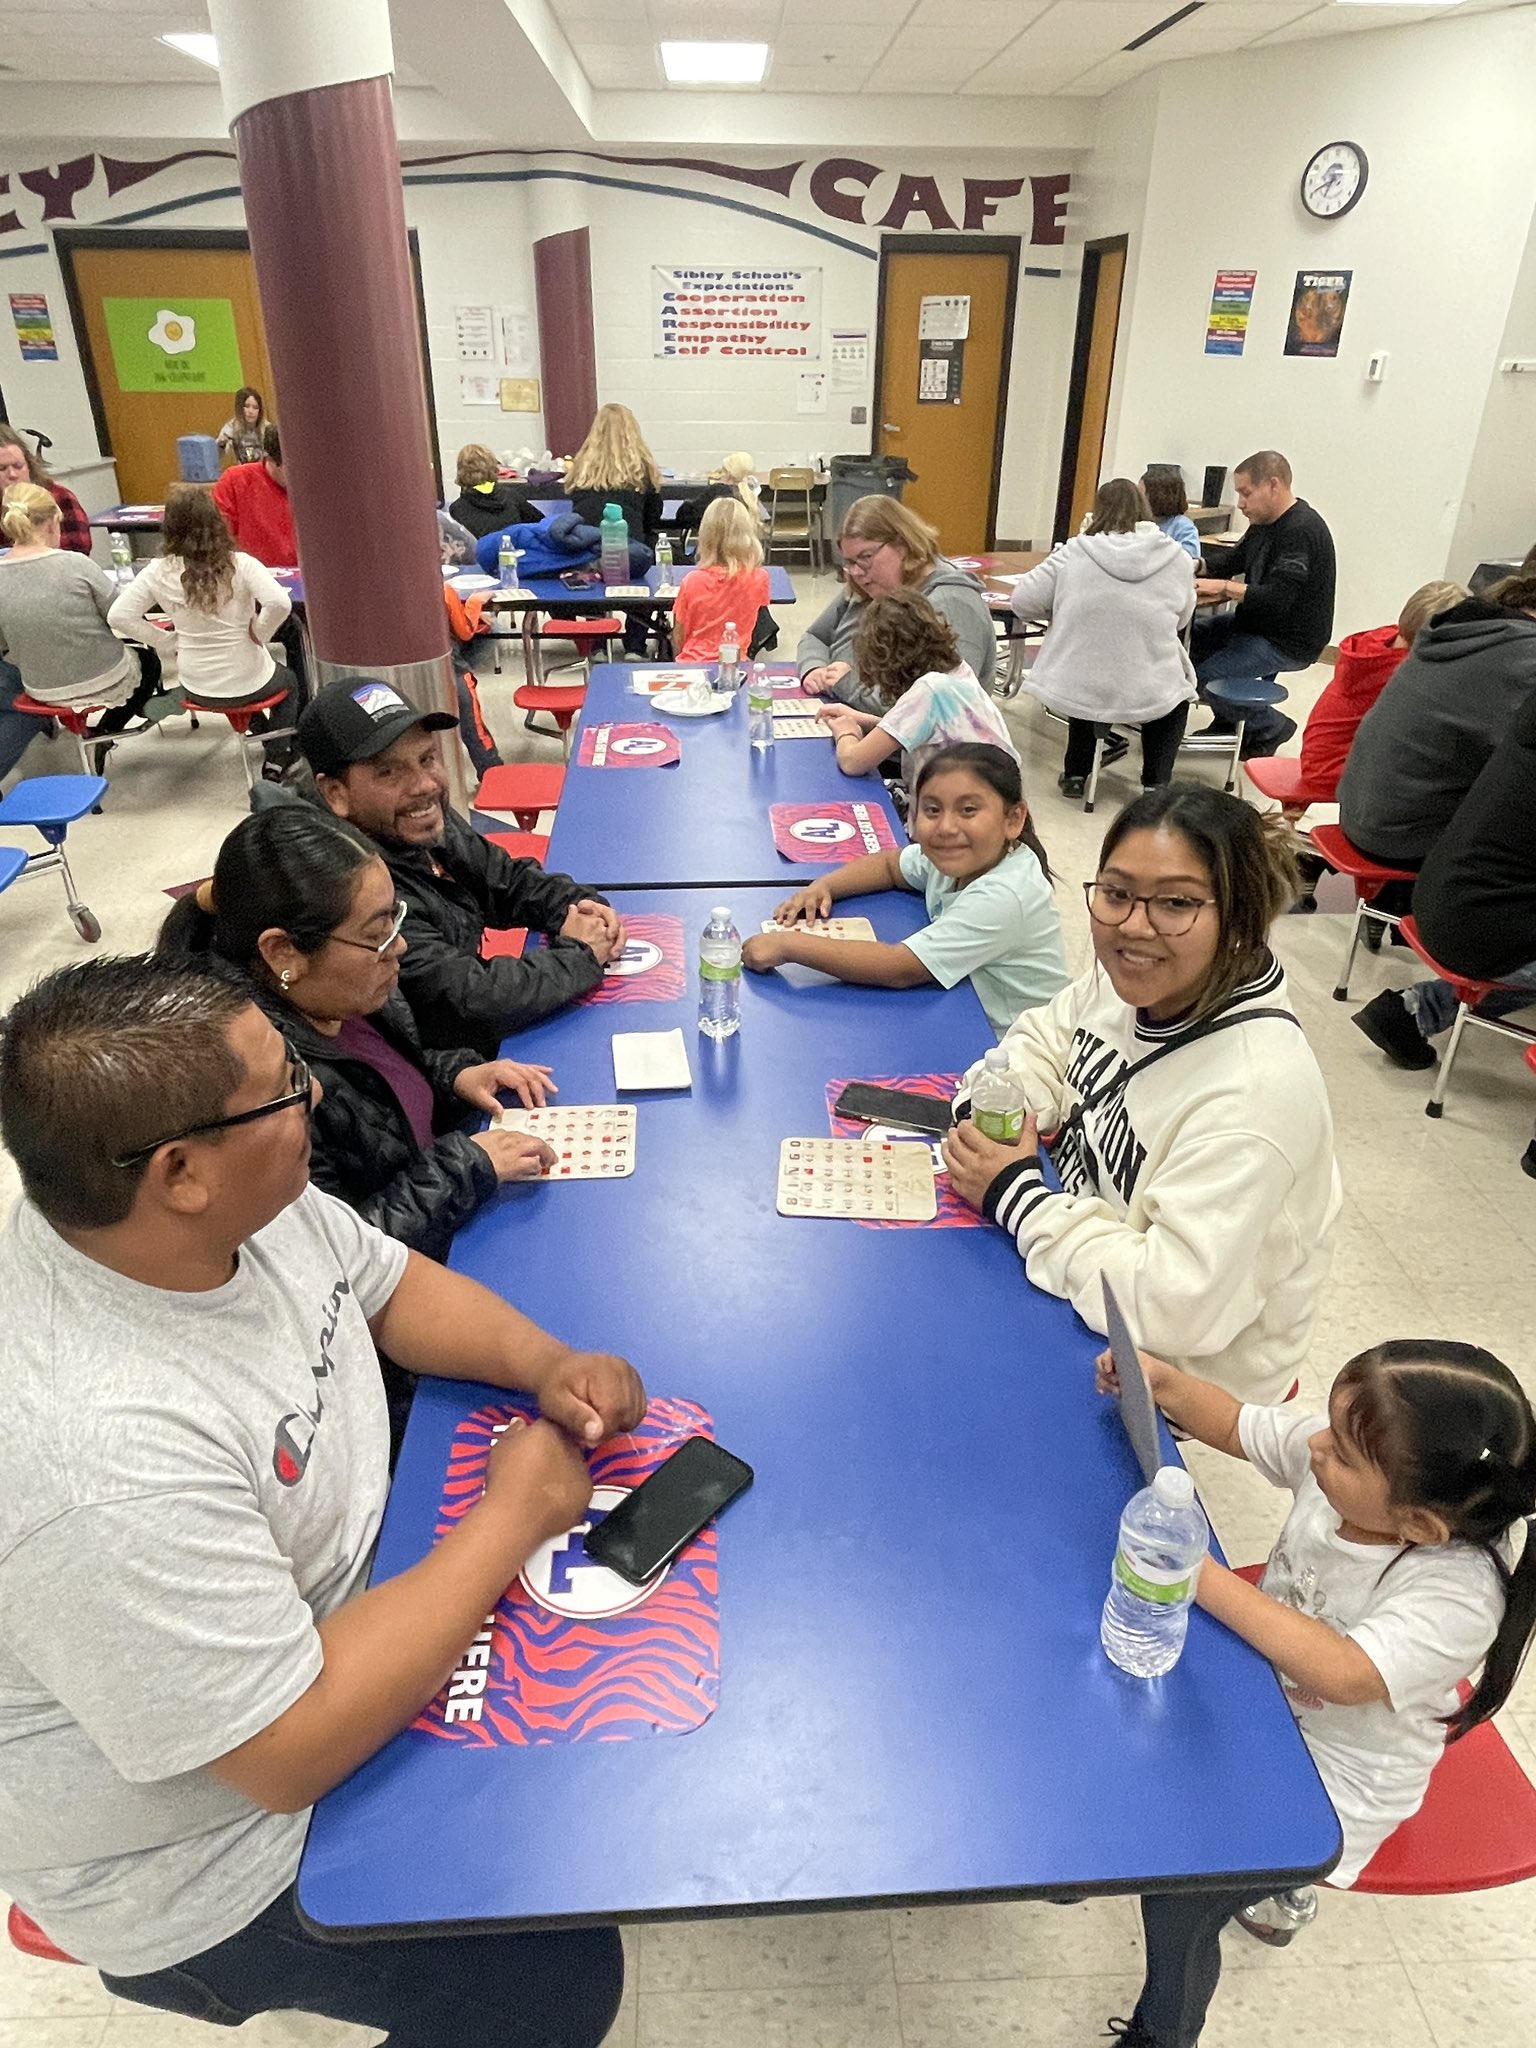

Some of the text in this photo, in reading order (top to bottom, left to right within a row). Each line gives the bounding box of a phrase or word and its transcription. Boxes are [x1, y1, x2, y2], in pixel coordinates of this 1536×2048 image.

[810, 158, 1071, 246] CAFE
[673, 270, 802, 280] Sibley School's
[1303, 274, 1345, 287] TIGER
[682, 281, 794, 291] Expectations
[662, 292, 806, 303] Cooperation
[661, 305, 778, 316] Assertion
[662, 319, 811, 331] Responsibility
[664, 332, 768, 344] Empathy
[663, 345, 807, 356] Self Control
[801, 822, 841, 839] AL
